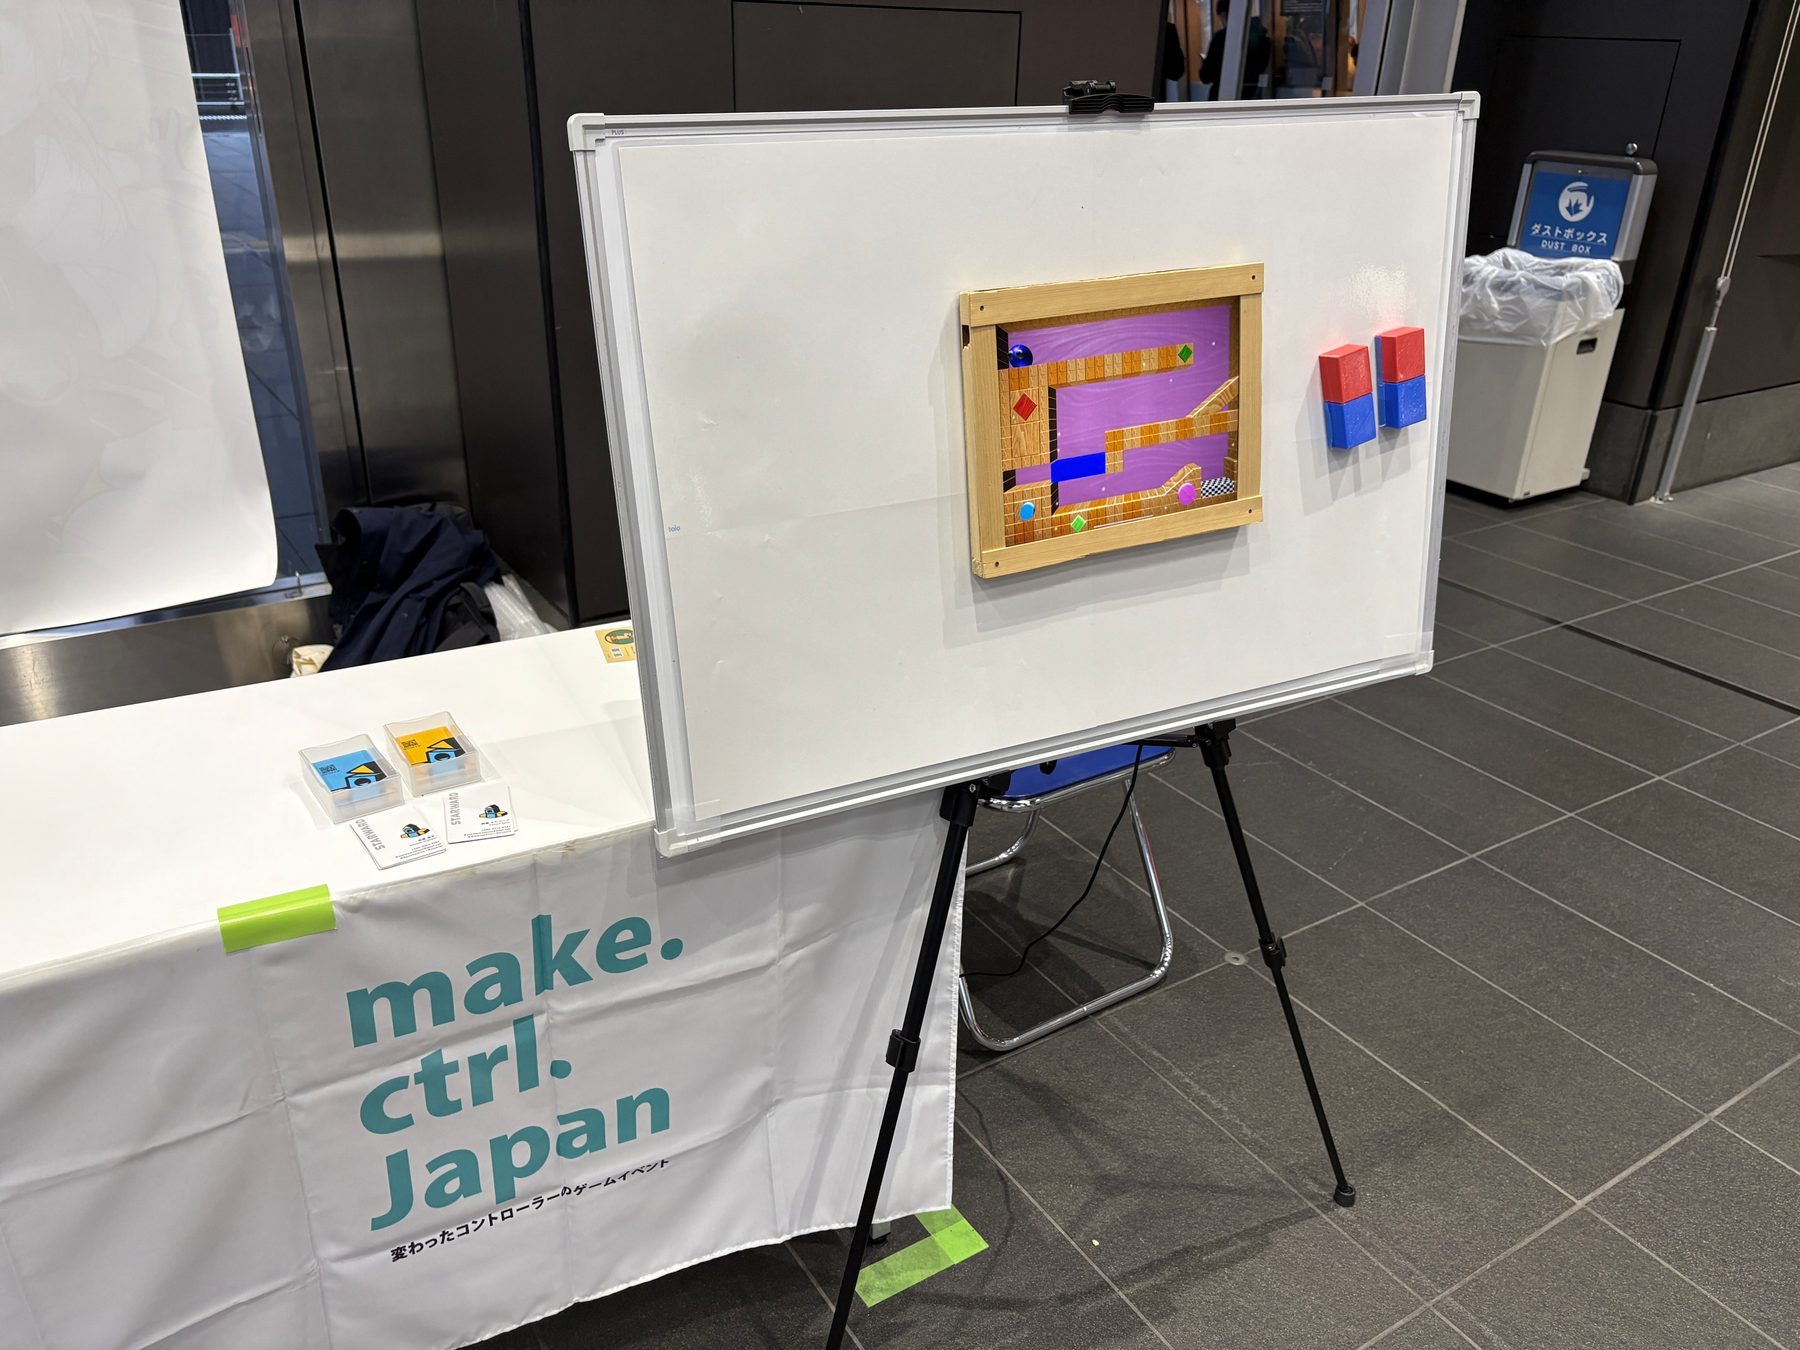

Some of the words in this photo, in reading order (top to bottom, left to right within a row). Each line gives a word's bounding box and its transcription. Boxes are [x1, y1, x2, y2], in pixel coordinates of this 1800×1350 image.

[1530, 223, 1608, 245] ダストボックス
[1541, 240, 1566, 251] DUST
[1571, 244, 1591, 255] BOX
[355, 818, 386, 851] STARWARD
[448, 791, 462, 826] STARWARD
[346, 914, 684, 1048] make.
[360, 1014, 572, 1135] ctrl.
[371, 1087, 670, 1231] Japan
[390, 1158, 670, 1262] 変わったコントローラーのゲームイベント
